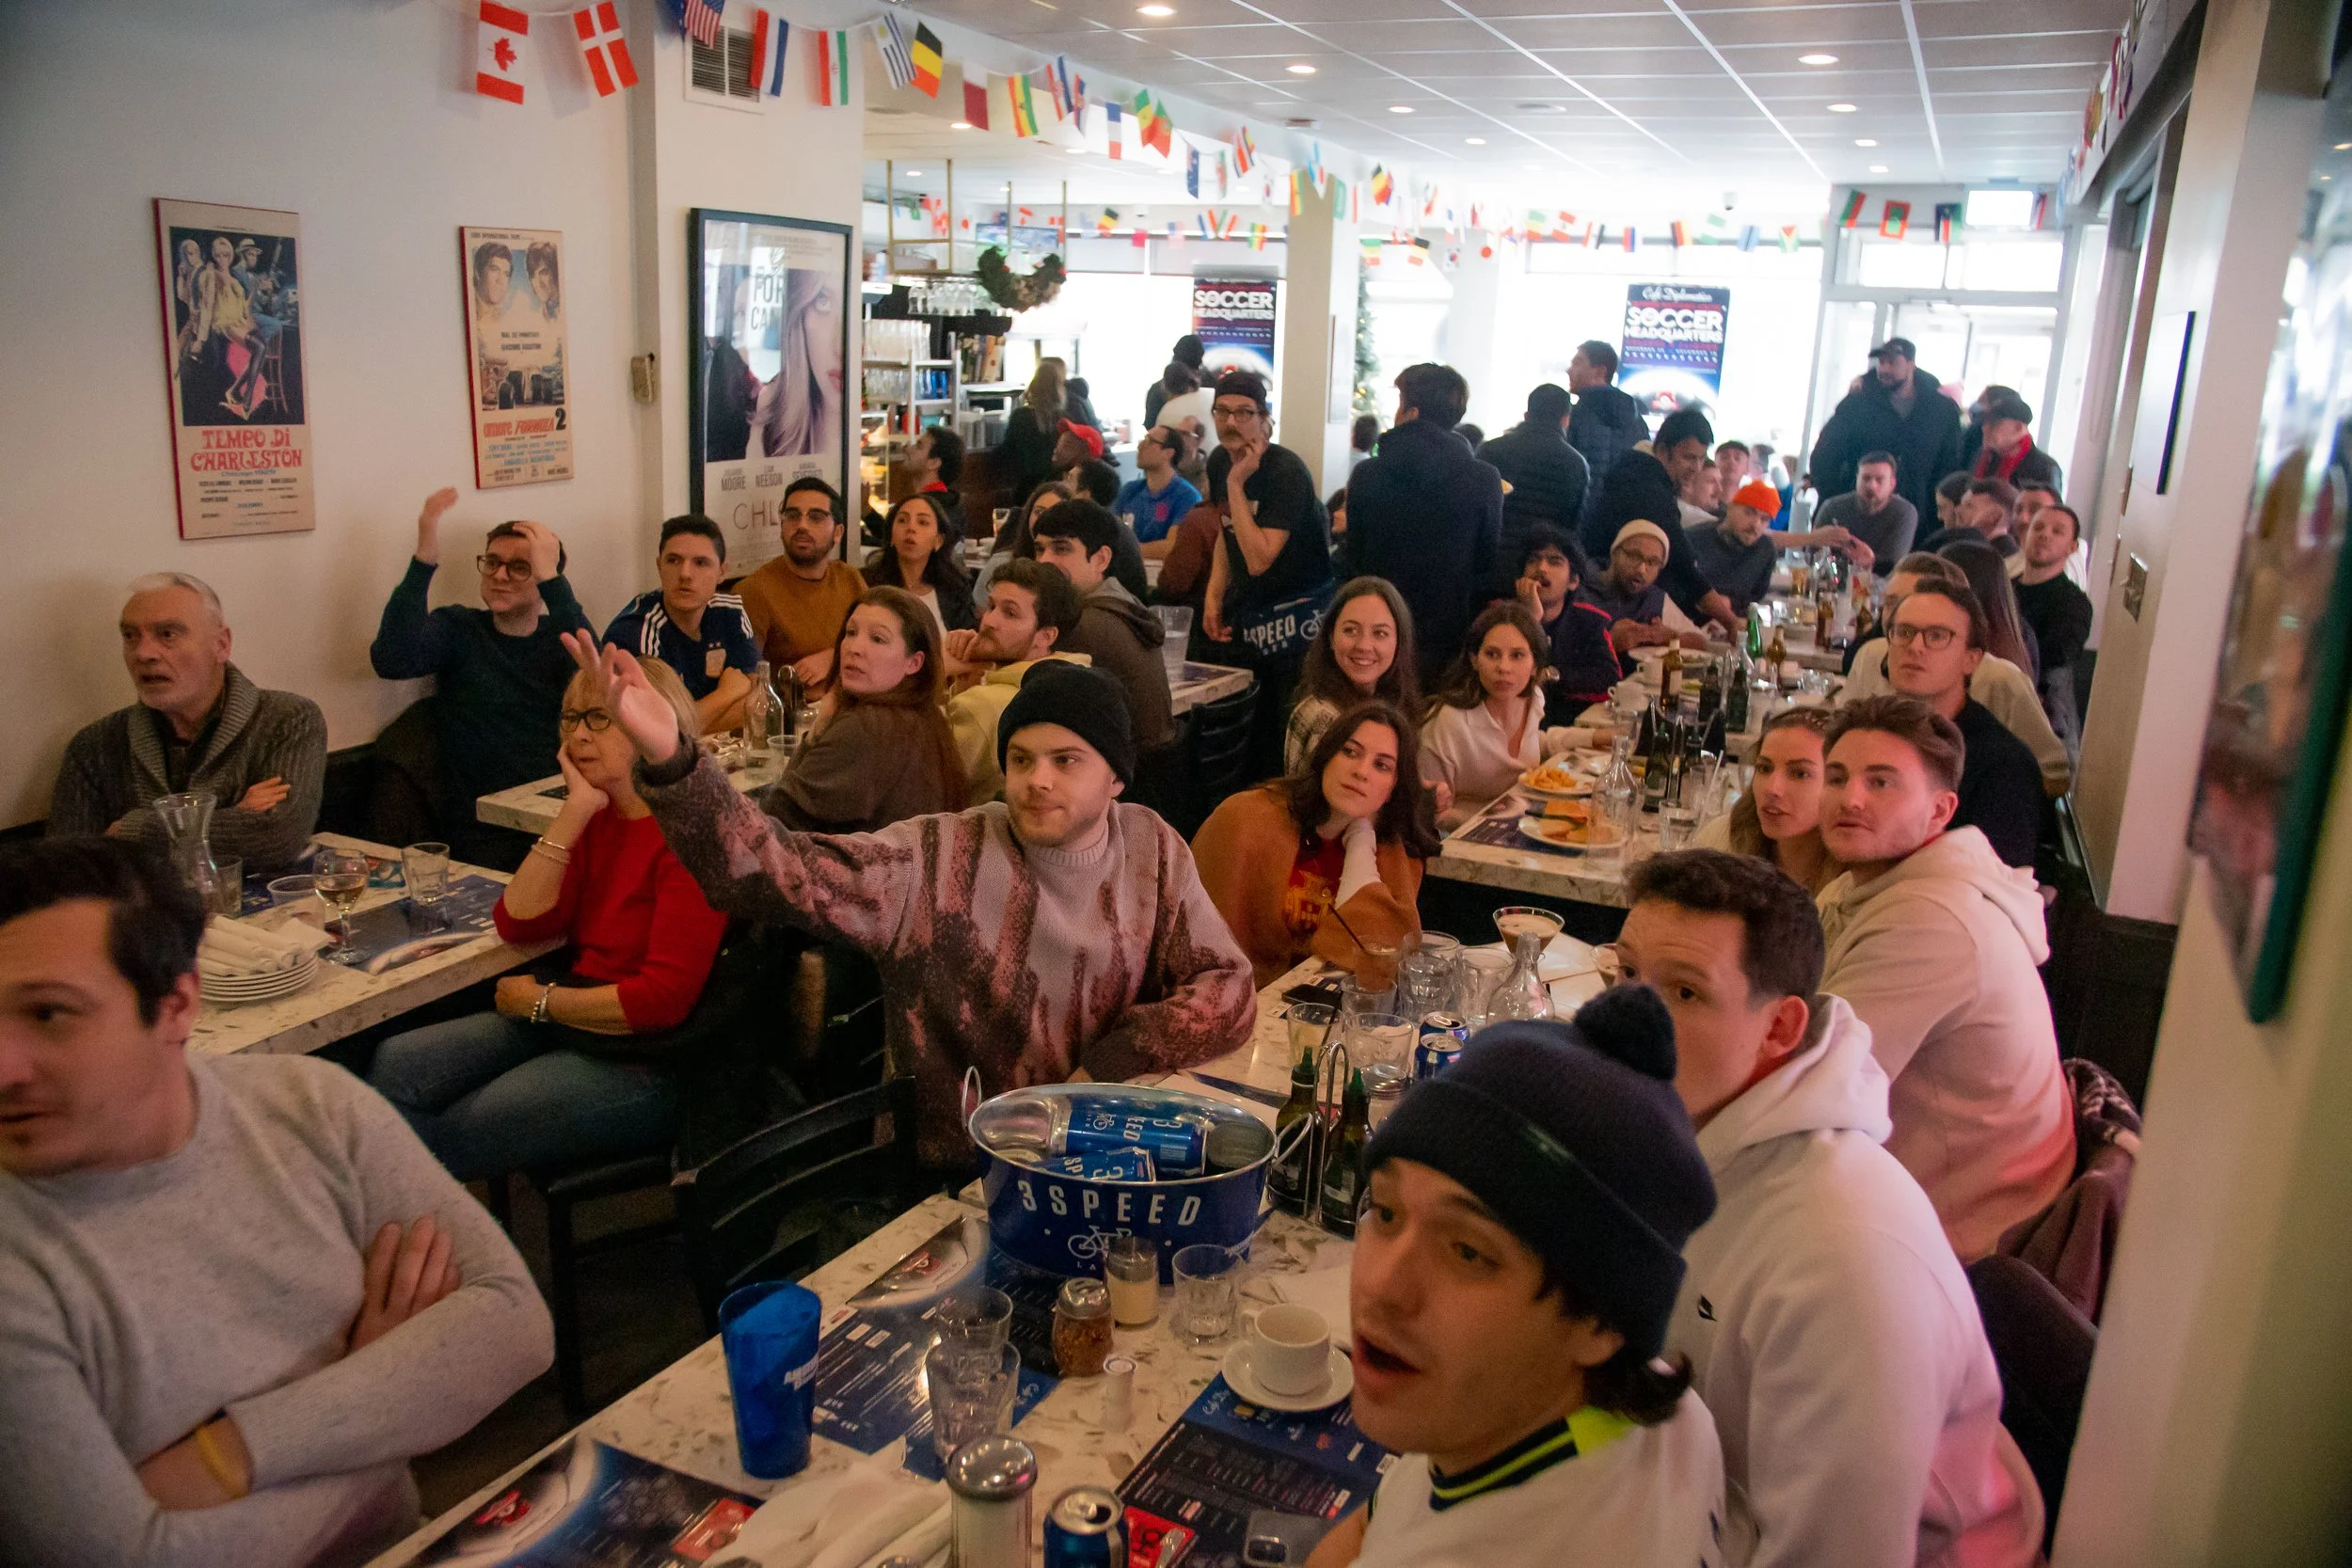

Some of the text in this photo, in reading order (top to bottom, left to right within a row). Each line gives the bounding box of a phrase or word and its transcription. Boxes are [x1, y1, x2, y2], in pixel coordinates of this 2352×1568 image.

[1194, 290, 1274, 309] SOCCER
[1192, 309, 1275, 321] HEADQUARTERS
[1627, 306, 1724, 331] SOCCER
[1624, 325, 1724, 344] HEADQUARTERS
[555, 407, 566, 431] 2
[202, 430, 265, 449] TEMPO
[190, 449, 302, 472] CHARLESTON
[721, 476, 746, 491] MOORE
[755, 472, 783, 487] NEESON
[733, 499, 783, 531] CHL
[1017, 1180, 1200, 1226] 3 SPEED
